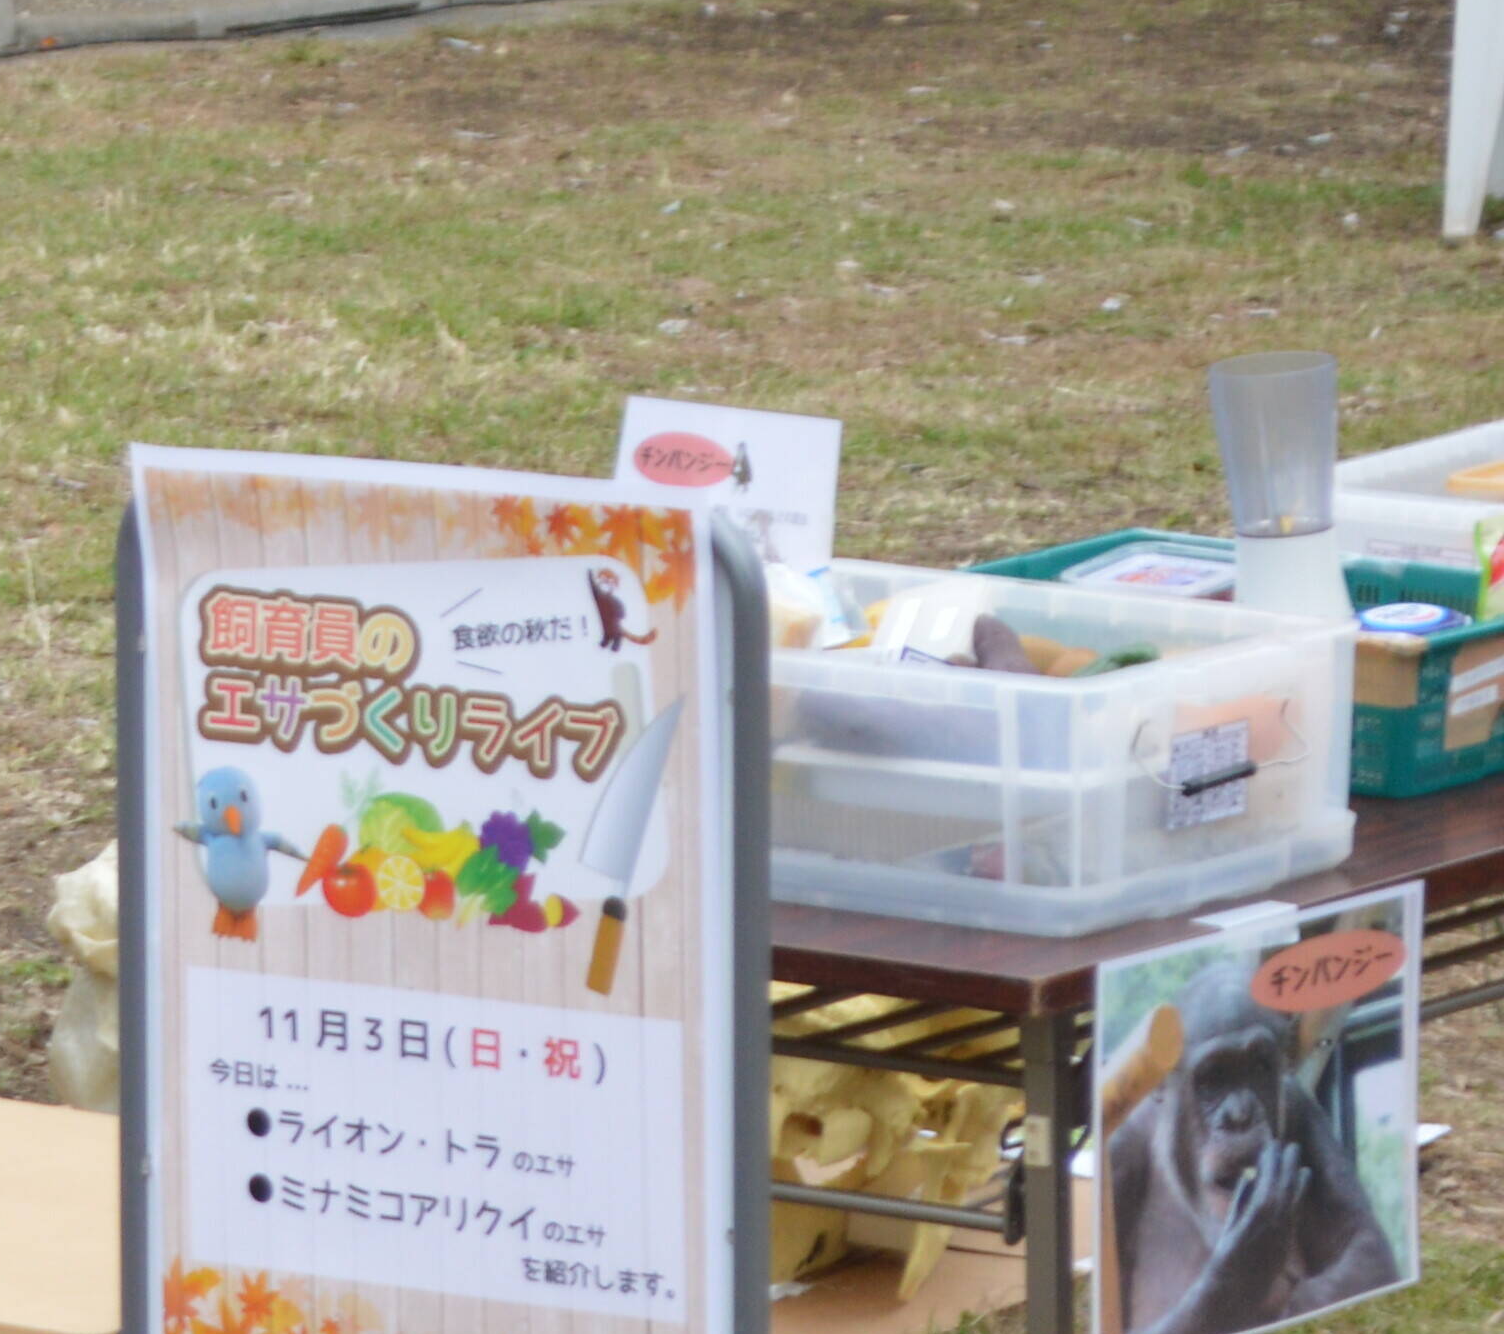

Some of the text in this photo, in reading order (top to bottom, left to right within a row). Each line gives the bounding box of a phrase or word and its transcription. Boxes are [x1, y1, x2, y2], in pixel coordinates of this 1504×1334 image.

[204, 590, 414, 669] 飼育員の
[452, 614, 589, 650] 食欲の秋だ！
[203, 675, 621, 771] エサづくりライブ
[1270, 945, 1395, 998] チンパンジー
[521, 1256, 678, 1301] を紹介します。
